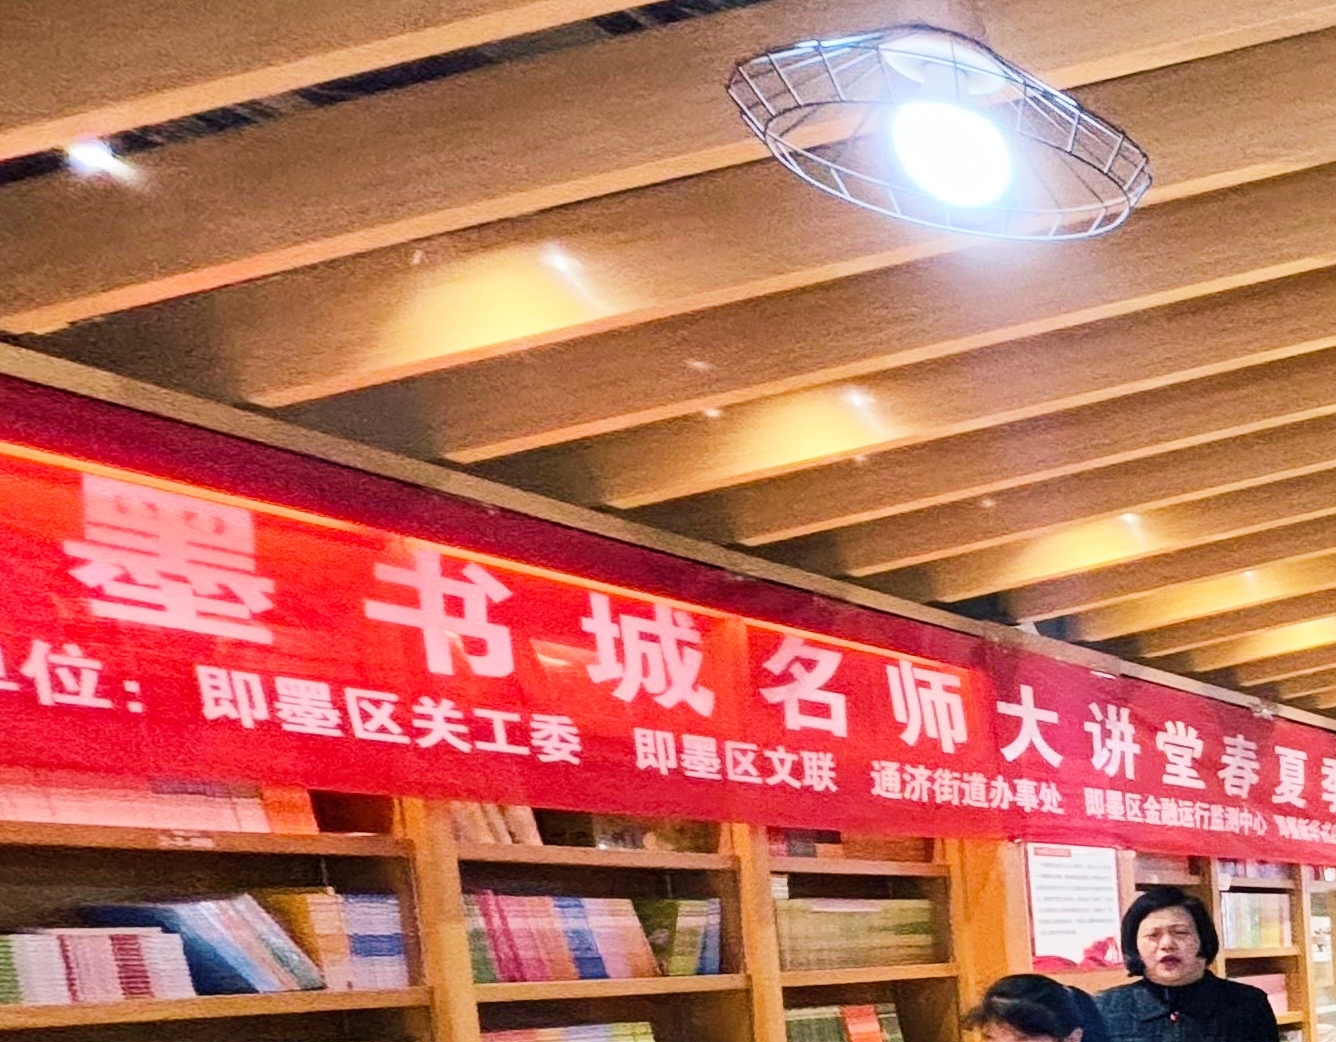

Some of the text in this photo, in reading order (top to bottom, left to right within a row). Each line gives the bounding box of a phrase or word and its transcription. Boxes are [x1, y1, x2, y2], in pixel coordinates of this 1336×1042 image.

[633, 727, 838, 793] 即墨区文联
[870, 760, 1065, 815] 通济街道办事处
[1084, 787, 1267, 836] 即墨区金融运行监测中心
